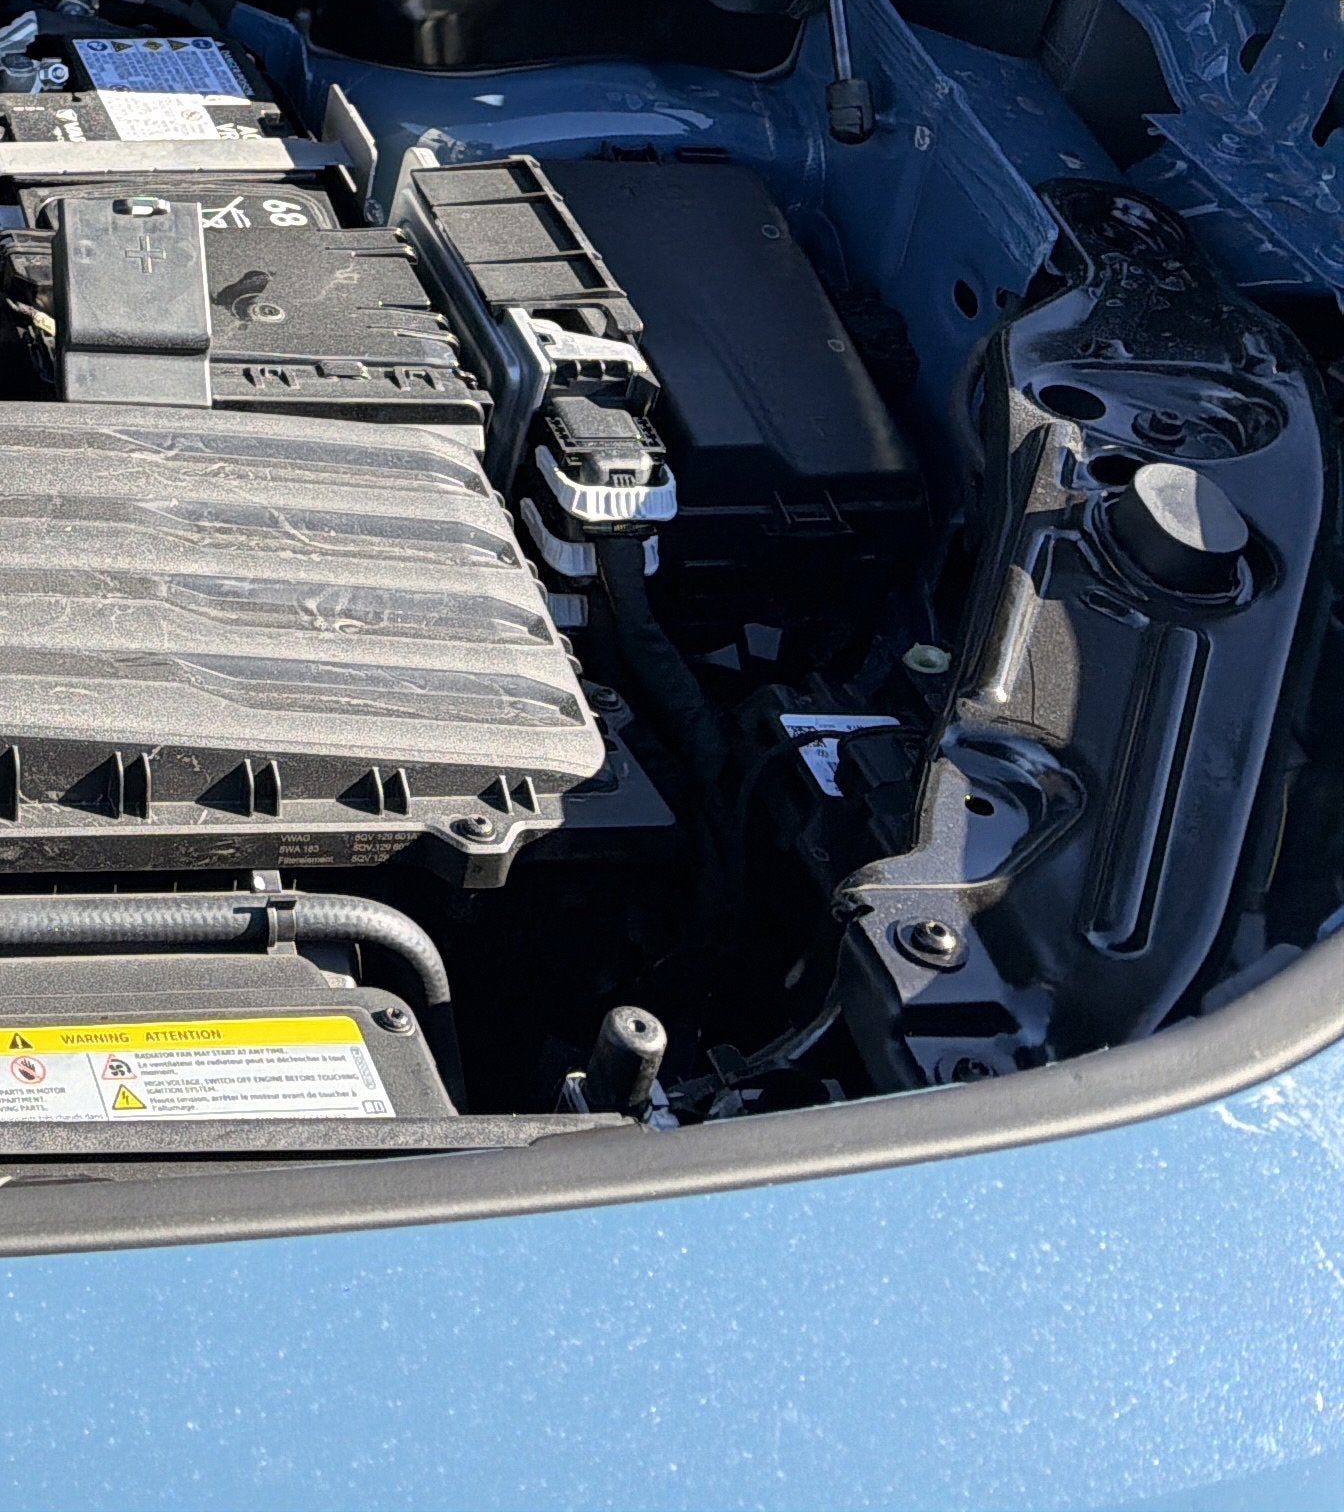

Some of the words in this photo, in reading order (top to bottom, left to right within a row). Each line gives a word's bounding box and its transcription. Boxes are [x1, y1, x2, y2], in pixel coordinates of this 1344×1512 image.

[262, 198, 311, 227] 68
[278, 856, 334, 865] Filterelement
[61, 1032, 130, 1045] WARNING
[145, 1029, 222, 1042] ATTENTION
[134, 1051, 175, 1059] RADIATOR
[175, 1050, 192, 1058] FAN
[149, 1060, 193, 1068] ventilateur
[207, 1058, 243, 1066] radiateur
[204, 1077, 235, 1085] SWITCH
[254, 1075, 283, 1083] ENGINE
[285, 1074, 316, 1082] BEFORE
[317, 1073, 360, 1081] TOUCHING
[0, 1088, 25, 1096] PARTS
[36, 1086, 66, 1095] MOTOR
[146, 1087, 184, 1095] IGNITION
[318, 1090, 350, 1098] toucher
